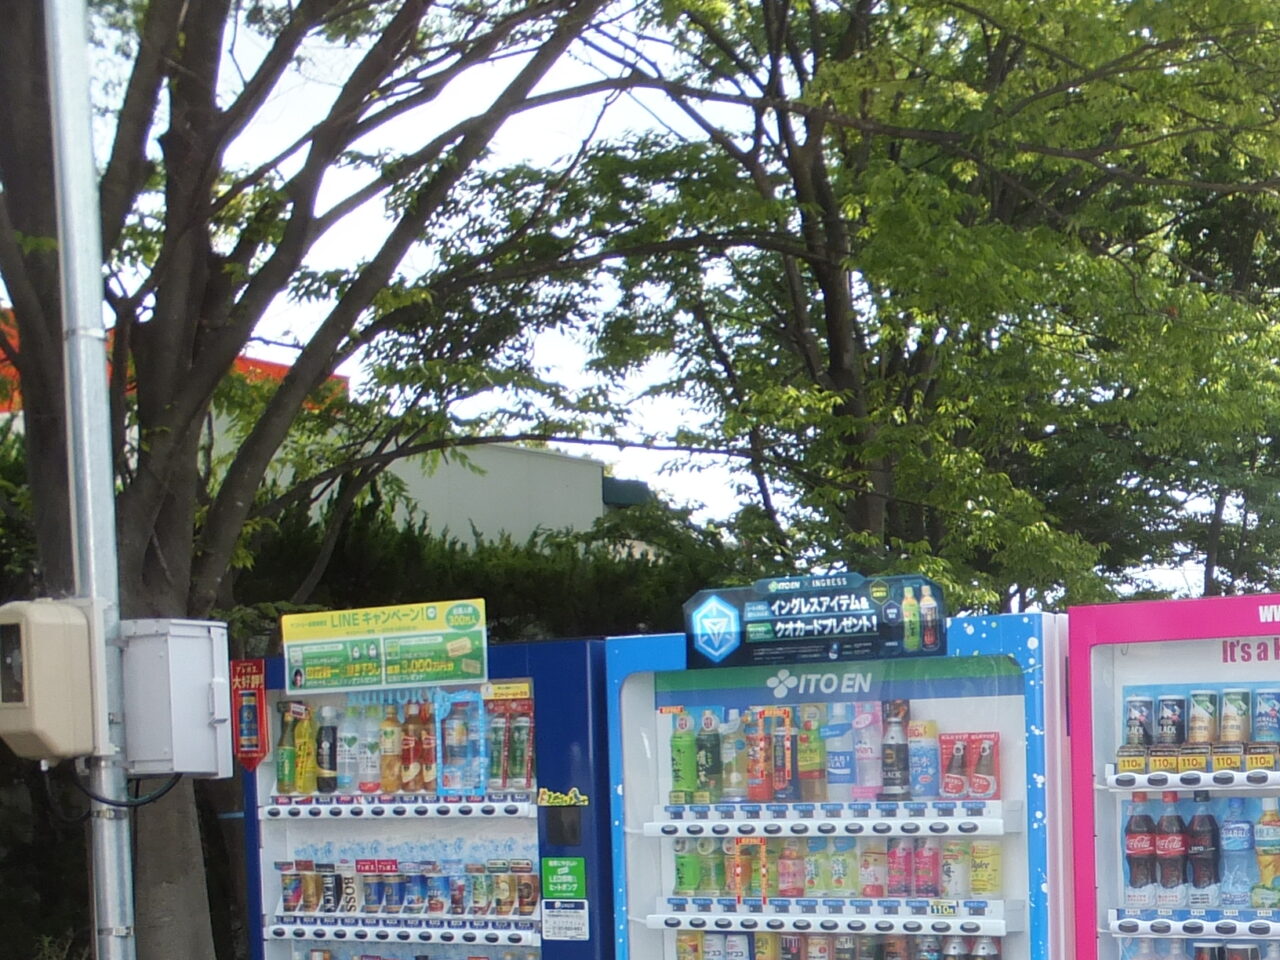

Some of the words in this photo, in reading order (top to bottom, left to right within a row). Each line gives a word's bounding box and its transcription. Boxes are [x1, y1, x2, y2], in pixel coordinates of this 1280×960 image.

[811, 577, 848, 588] INGRESS
[330, 613, 360, 629] LINE
[774, 615, 878, 639] クオカードプレゼント!
[1222, 639, 1253, 664] It's
[1256, 642, 1269, 662] a
[798, 673, 838, 695] ITO
[841, 672, 872, 694] EN
[344, 876, 357, 913] BOSS
